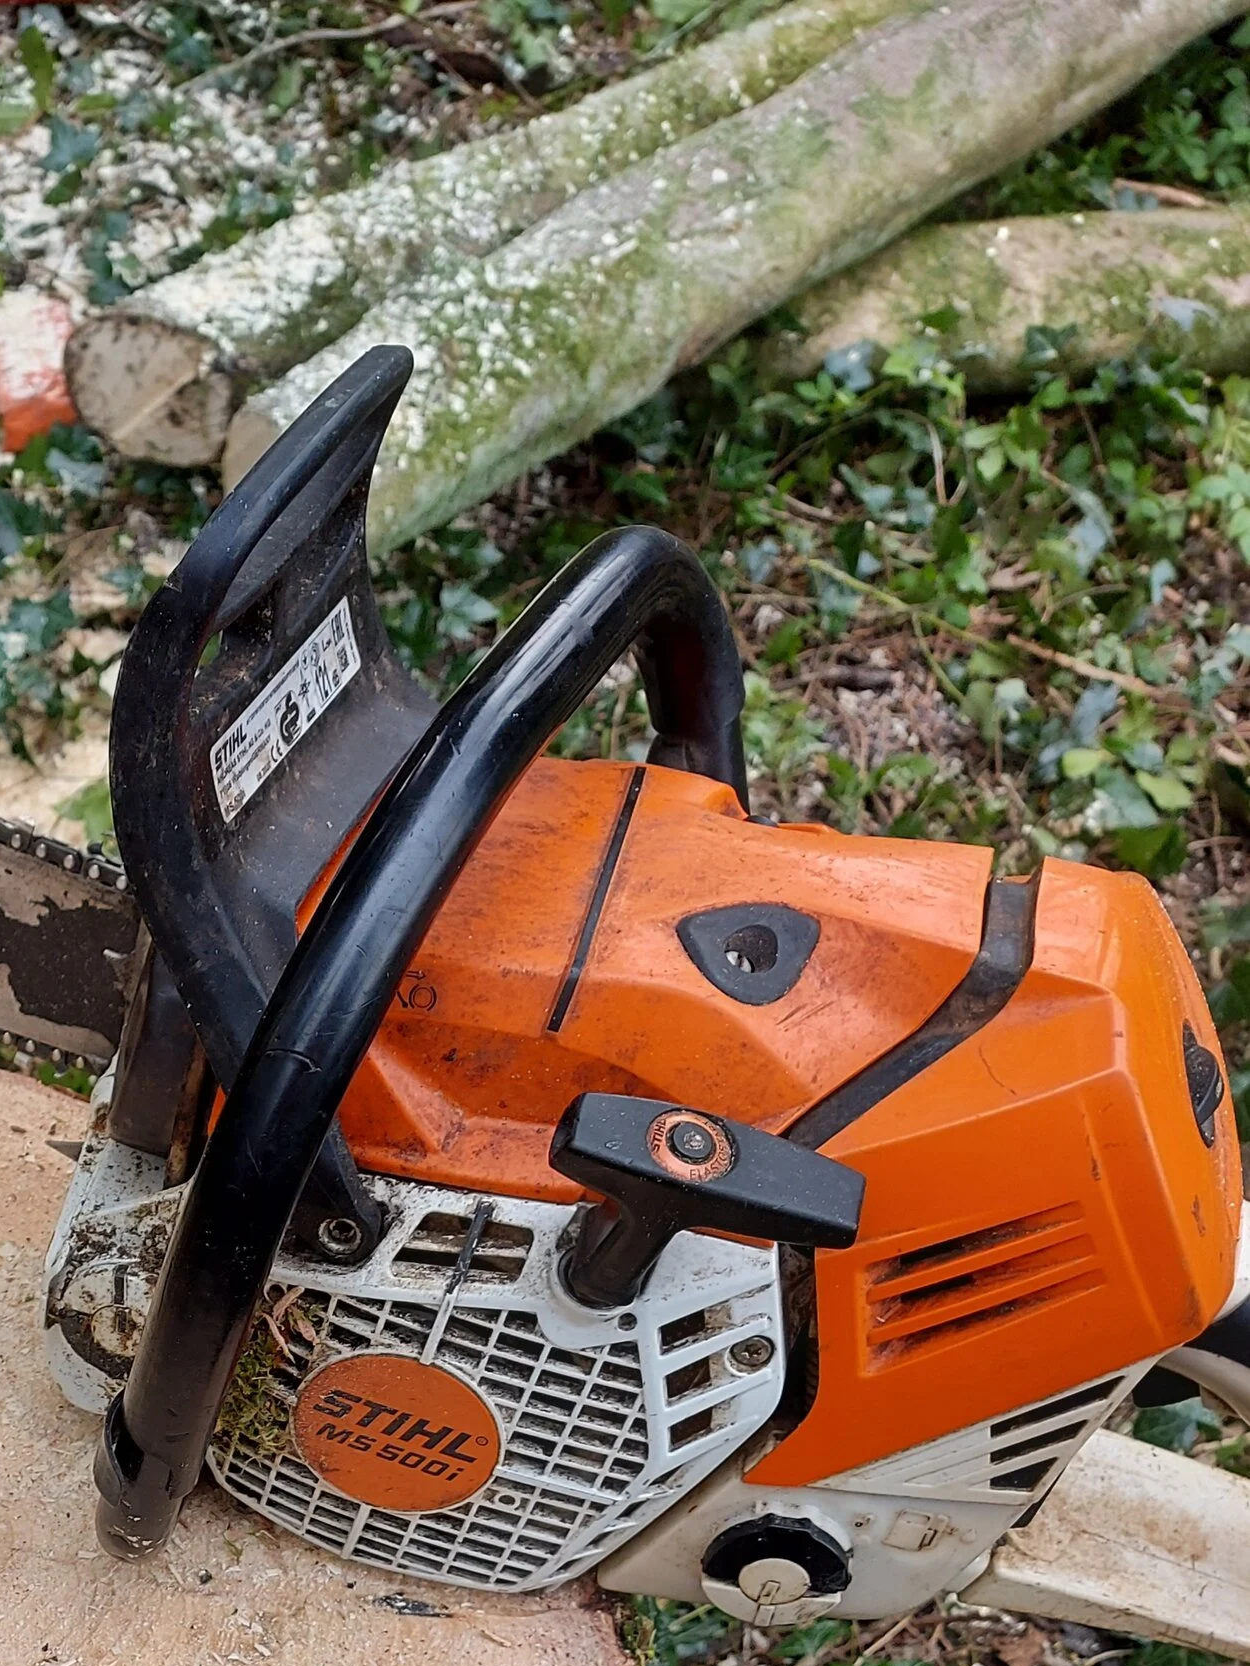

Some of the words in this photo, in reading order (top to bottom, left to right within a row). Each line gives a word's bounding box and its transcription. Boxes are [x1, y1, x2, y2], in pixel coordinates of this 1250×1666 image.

[215, 724, 248, 772] STIHL
[650, 1119, 667, 1154] STIHL
[313, 1389, 477, 1463] STIHL
[317, 1423, 377, 1452] MS
[376, 1444, 465, 1481] 500i
